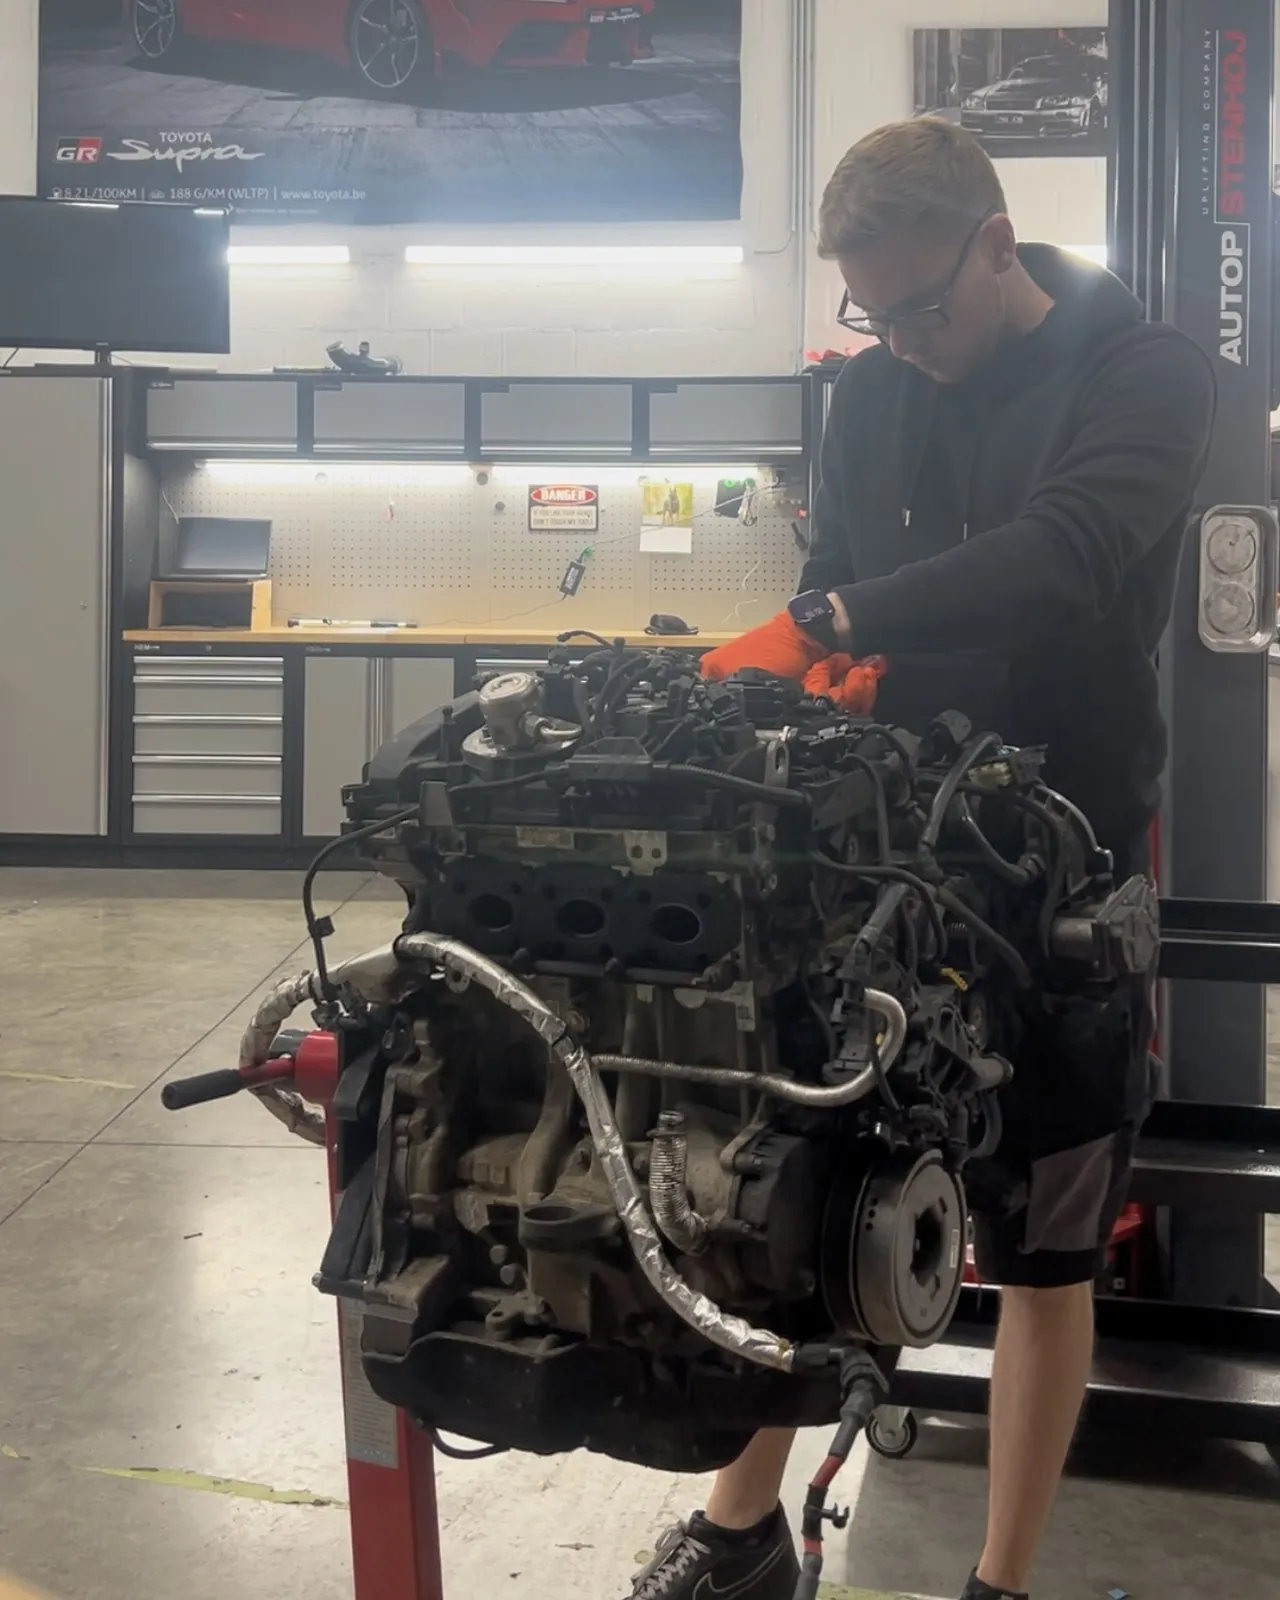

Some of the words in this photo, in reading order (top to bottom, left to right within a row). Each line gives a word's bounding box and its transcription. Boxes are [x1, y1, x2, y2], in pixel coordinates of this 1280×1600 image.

[1203, 29, 1211, 110] COMPANY
[160, 132, 212, 143] TOYOTA
[56, 147, 98, 161] GR
[106, 139, 265, 173] Supra
[1201, 123, 1210, 215] UPLIFTING
[169, 187, 192, 199] 188
[193, 187, 226, 200] G/KM
[228, 187, 269, 201] (WLTP)
[281, 188, 366, 202] www.toyota.be
[1220, 230, 1243, 365] AUTOP
[541, 489, 586, 501] DANGER
